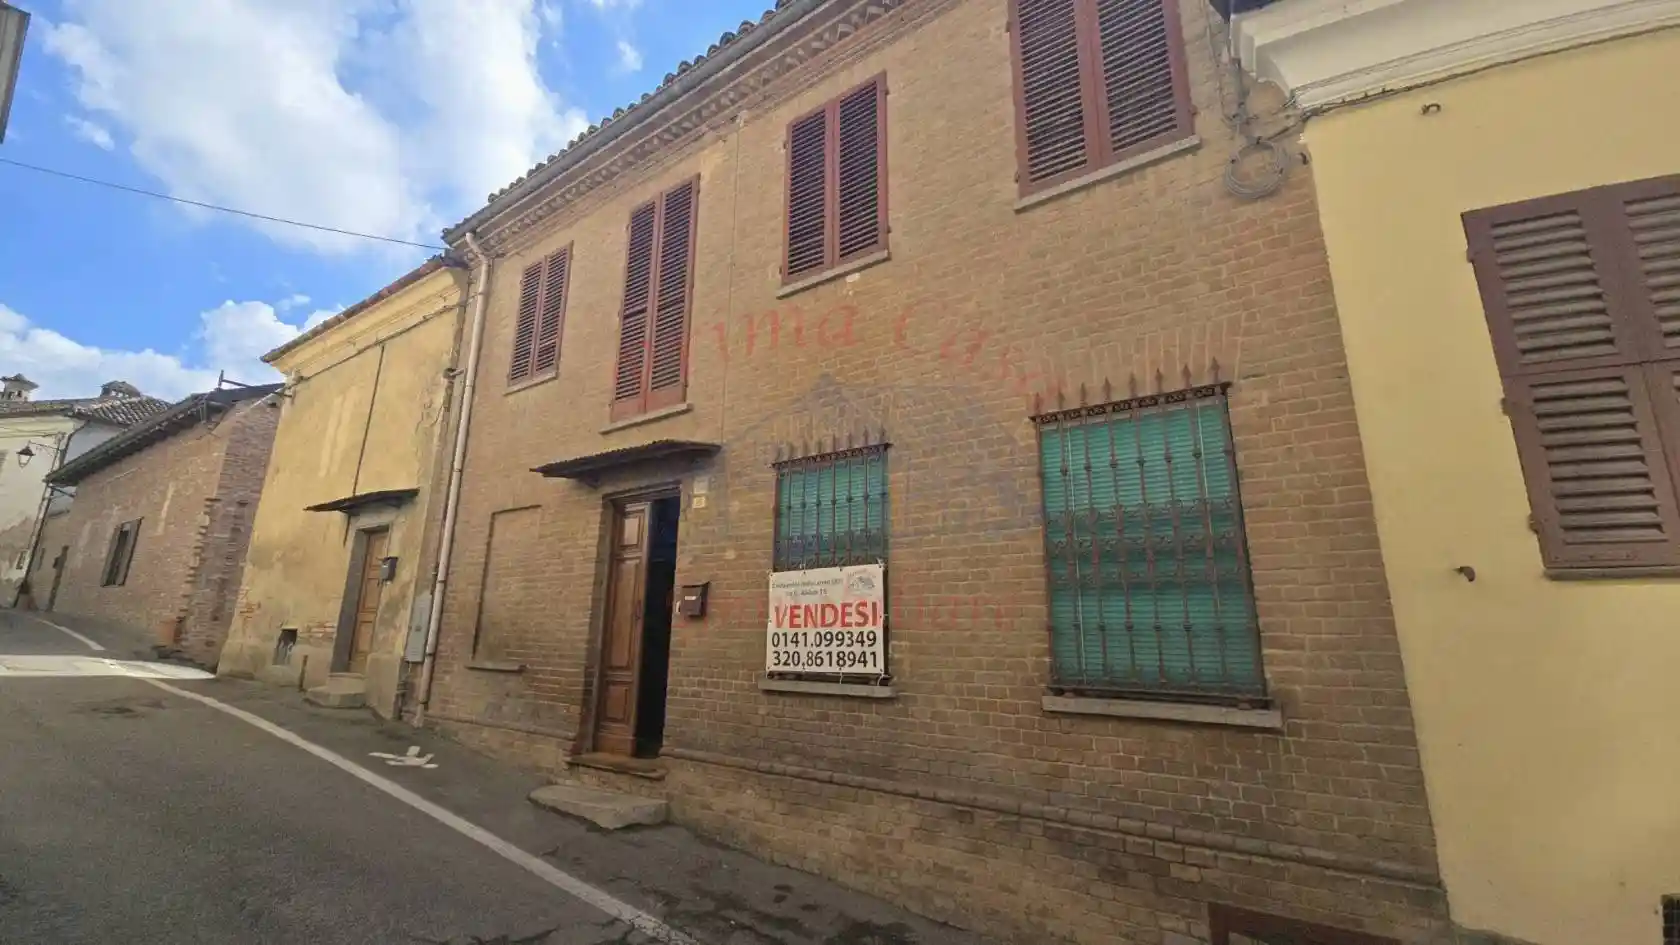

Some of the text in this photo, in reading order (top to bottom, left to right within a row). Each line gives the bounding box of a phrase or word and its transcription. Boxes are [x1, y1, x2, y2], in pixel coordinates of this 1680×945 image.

[774, 601, 877, 628] VENDESI
[771, 631, 877, 648] 0141.099349
[773, 651, 877, 668] 320.8618941
